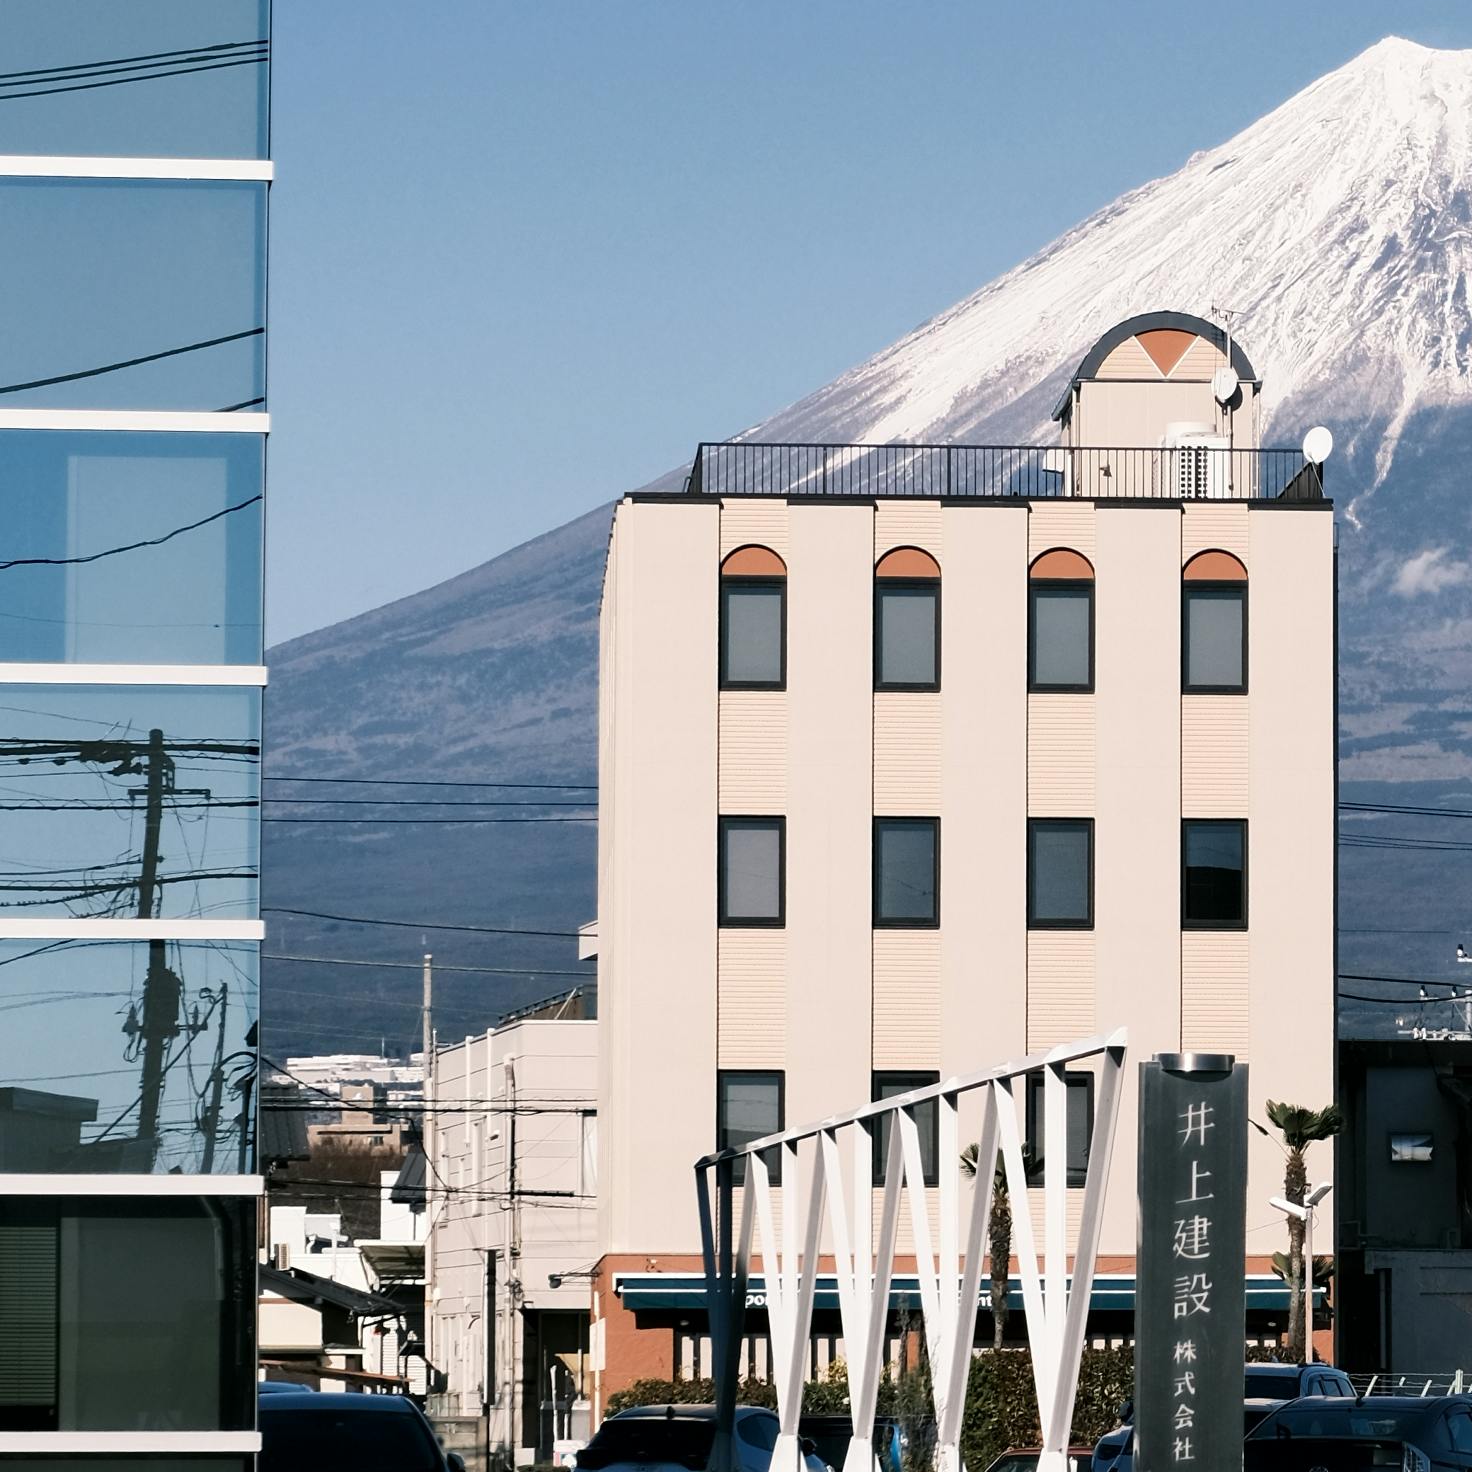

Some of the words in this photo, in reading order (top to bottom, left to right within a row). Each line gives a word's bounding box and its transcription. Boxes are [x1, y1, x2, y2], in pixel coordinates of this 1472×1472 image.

[1172, 1100, 1216, 1320] 井上建設
[1171, 1338, 1197, 1462] 株式会社
